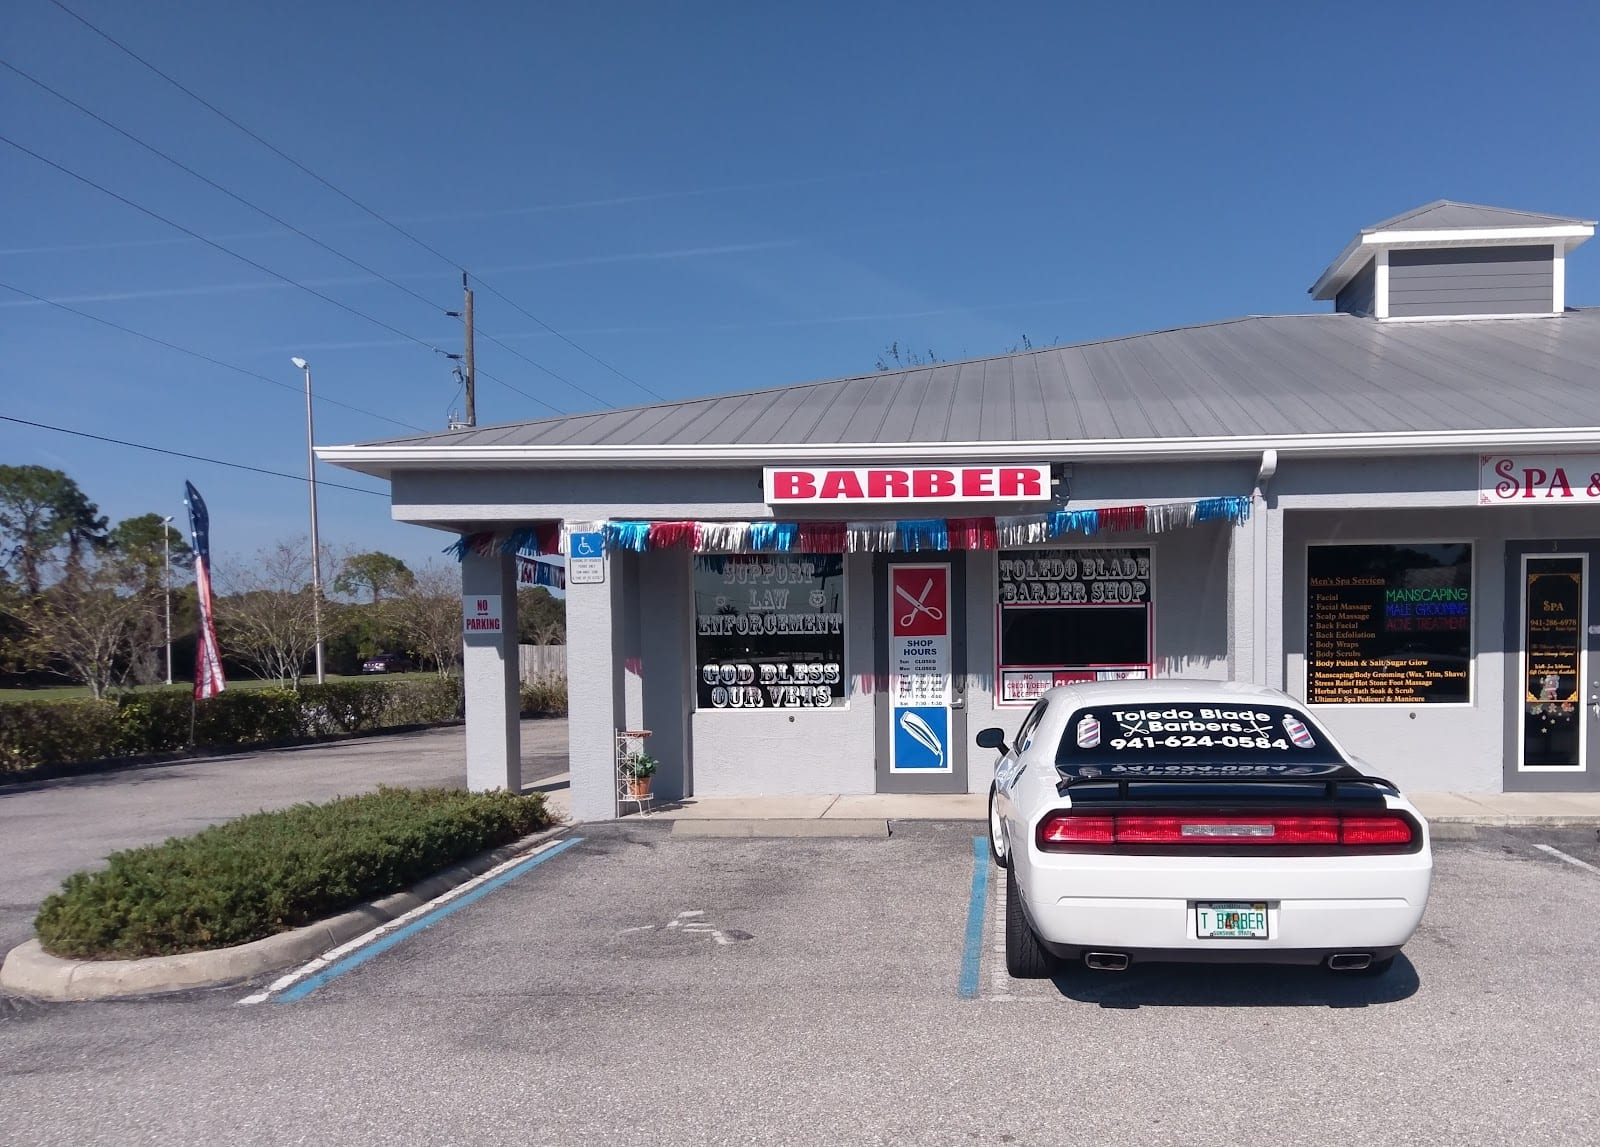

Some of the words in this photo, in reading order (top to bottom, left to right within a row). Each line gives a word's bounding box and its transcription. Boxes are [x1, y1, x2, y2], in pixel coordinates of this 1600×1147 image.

[774, 468, 1041, 499] BARBER
[723, 562, 814, 584] SUPPORT
[1000, 559, 1078, 580] TOLEDO
[1082, 558, 1149, 579] BLADE
[1311, 577, 1334, 587] Men's
[1335, 576, 1350, 587] Spa
[1352, 576, 1385, 586] Services
[1003, 582, 1087, 603] BARBER
[1091, 581, 1147, 602] SHOP
[1316, 593, 1339, 601] Facial
[1385, 589, 1468, 602] MANSCAPING
[477, 599, 488, 611] NO
[749, 589, 789, 609] LAW
[1316, 603, 1339, 611] Facial
[1341, 603, 1372, 611] Massage
[1386, 603, 1411, 616] MALE
[1316, 613, 1337, 621] Scalp
[1338, 612, 1370, 621] Massage
[466, 618, 500, 630] PARKING
[698, 613, 842, 635] ENFORCEMENT
[1315, 622, 1334, 630] Back
[1335, 631, 1376, 639] Exfoliation
[1315, 641, 1334, 650] Body
[1336, 641, 1359, 649] Wraps
[903, 648, 937, 656] HOURS
[1315, 650, 1334, 659] Body
[1336, 650, 1361, 658] Scrubs
[1315, 660, 1335, 669] Body
[1369, 660, 1407, 668] Salt/Sugar
[1408, 659, 1429, 667] Glow
[703, 664, 754, 685] GOD
[759, 663, 840, 684] BLESS
[1314, 672, 1372, 680] Manscaping/Body
[1372, 671, 1406, 679] Grooming
[1406, 671, 1424, 679] (Wax,
[1425, 671, 1443, 679] Trim,
[1444, 670, 1467, 679] Shave)
[1314, 680, 1335, 688] Stress
[1405, 680, 1433, 688] Massage
[712, 686, 763, 707] OUR
[767, 686, 832, 707] VETS
[1314, 688, 1337, 696] Herbal
[1314, 696, 1343, 704] Ultimate
[1343, 696, 1356, 704] Spa
[1357, 696, 1385, 704] Pedicure
[1112, 710, 1194, 722] Toledo
[1199, 709, 1271, 722] Blade
[1150, 720, 1242, 732] Barbers
[1110, 736, 1289, 750] 941-624-0584
[1201, 912, 1208, 929] T
[1216, 912, 1264, 930] BARBER
